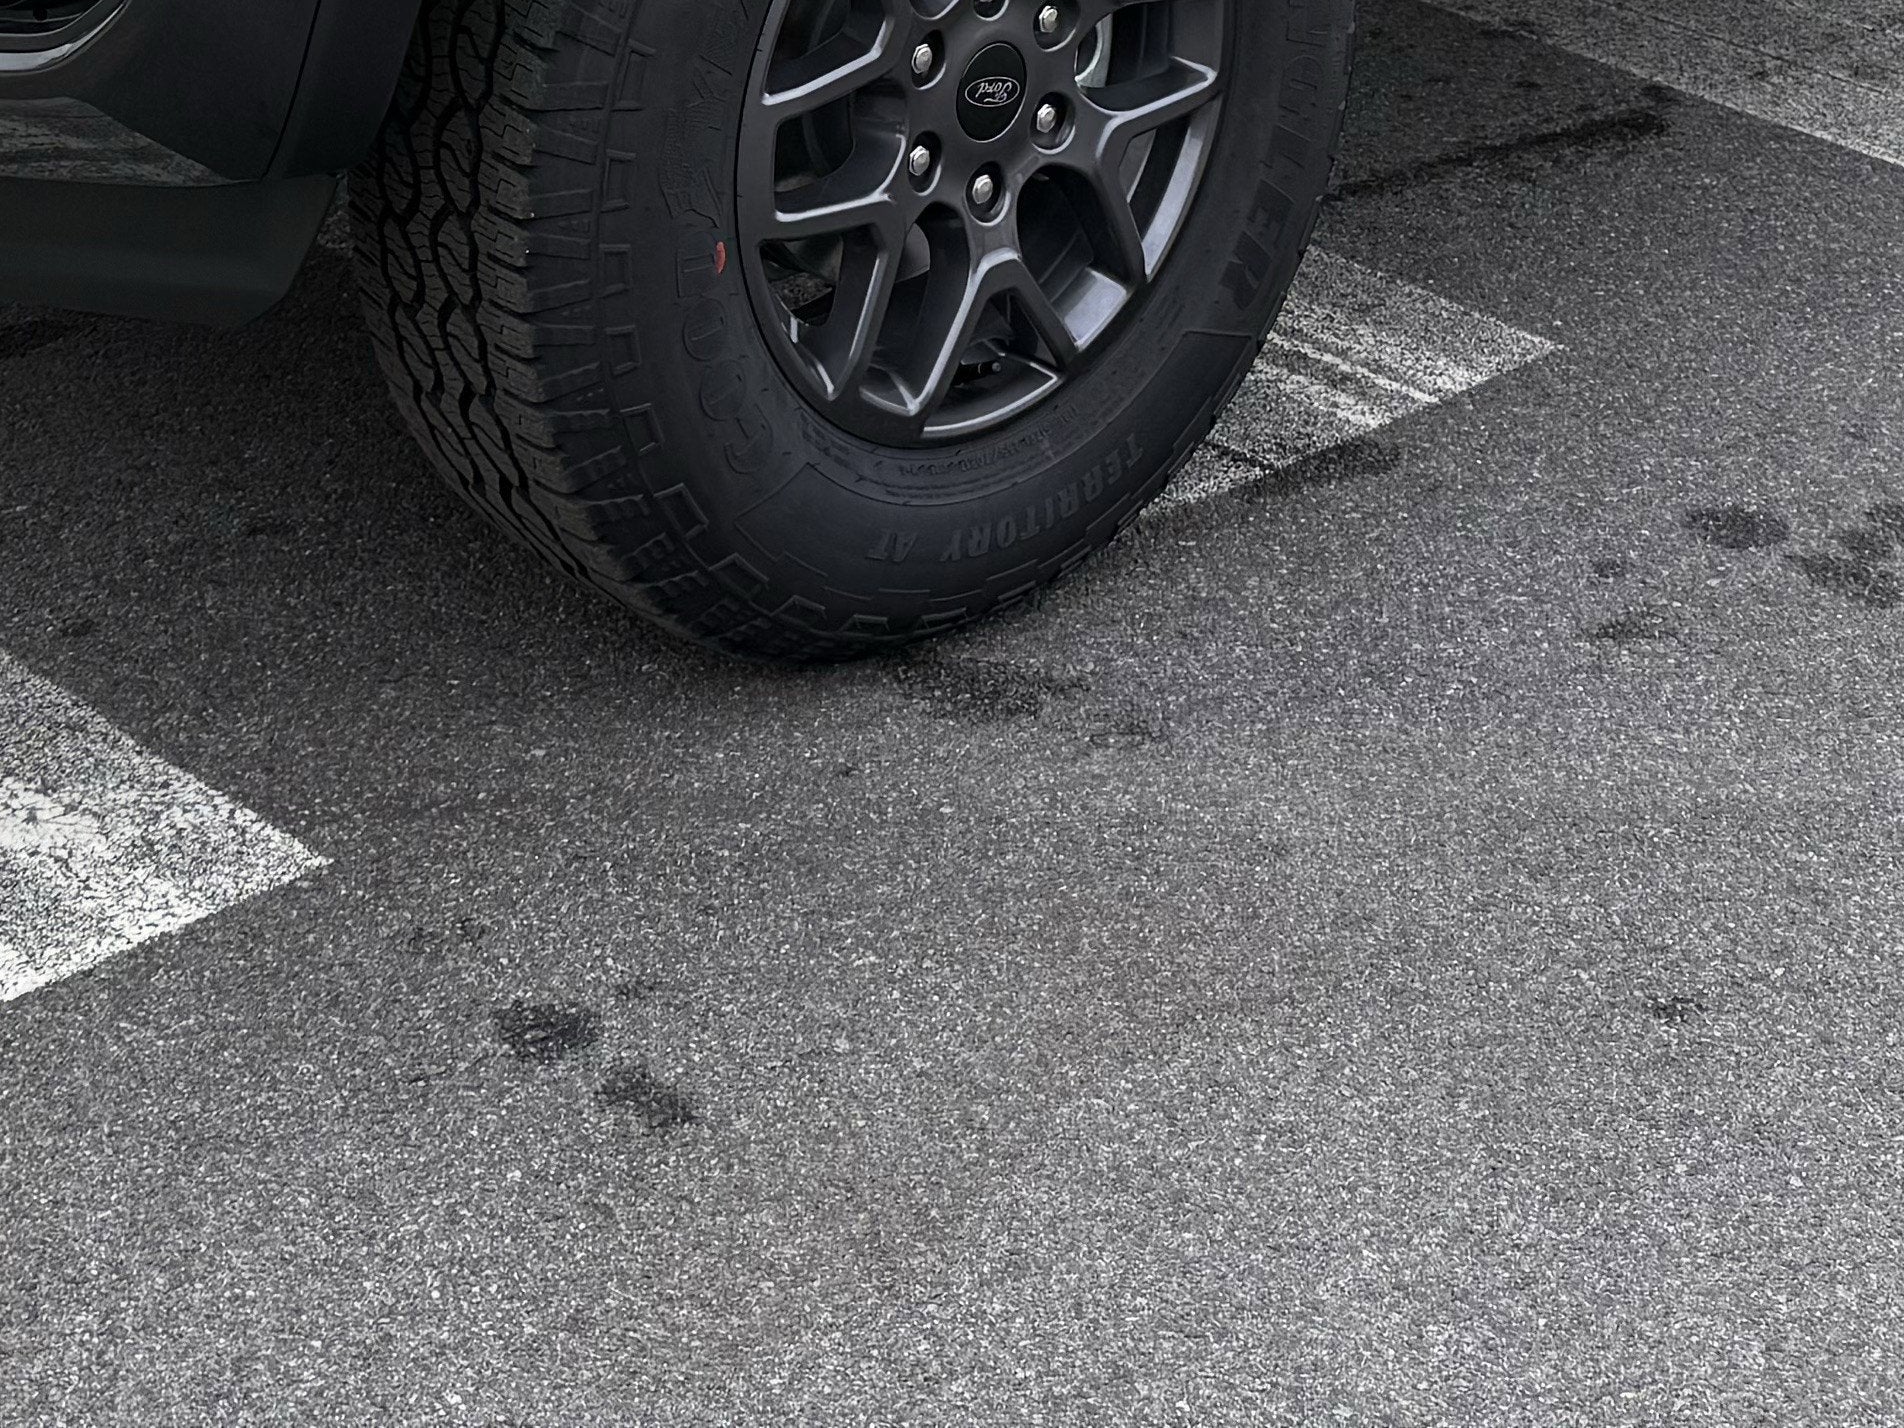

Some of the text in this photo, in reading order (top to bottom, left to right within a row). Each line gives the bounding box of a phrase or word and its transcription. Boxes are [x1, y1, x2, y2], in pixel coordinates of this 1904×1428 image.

[975, 81, 1012, 103] Ford
[939, 433, 1144, 563] TERRITORY
[865, 528, 920, 563] AT
